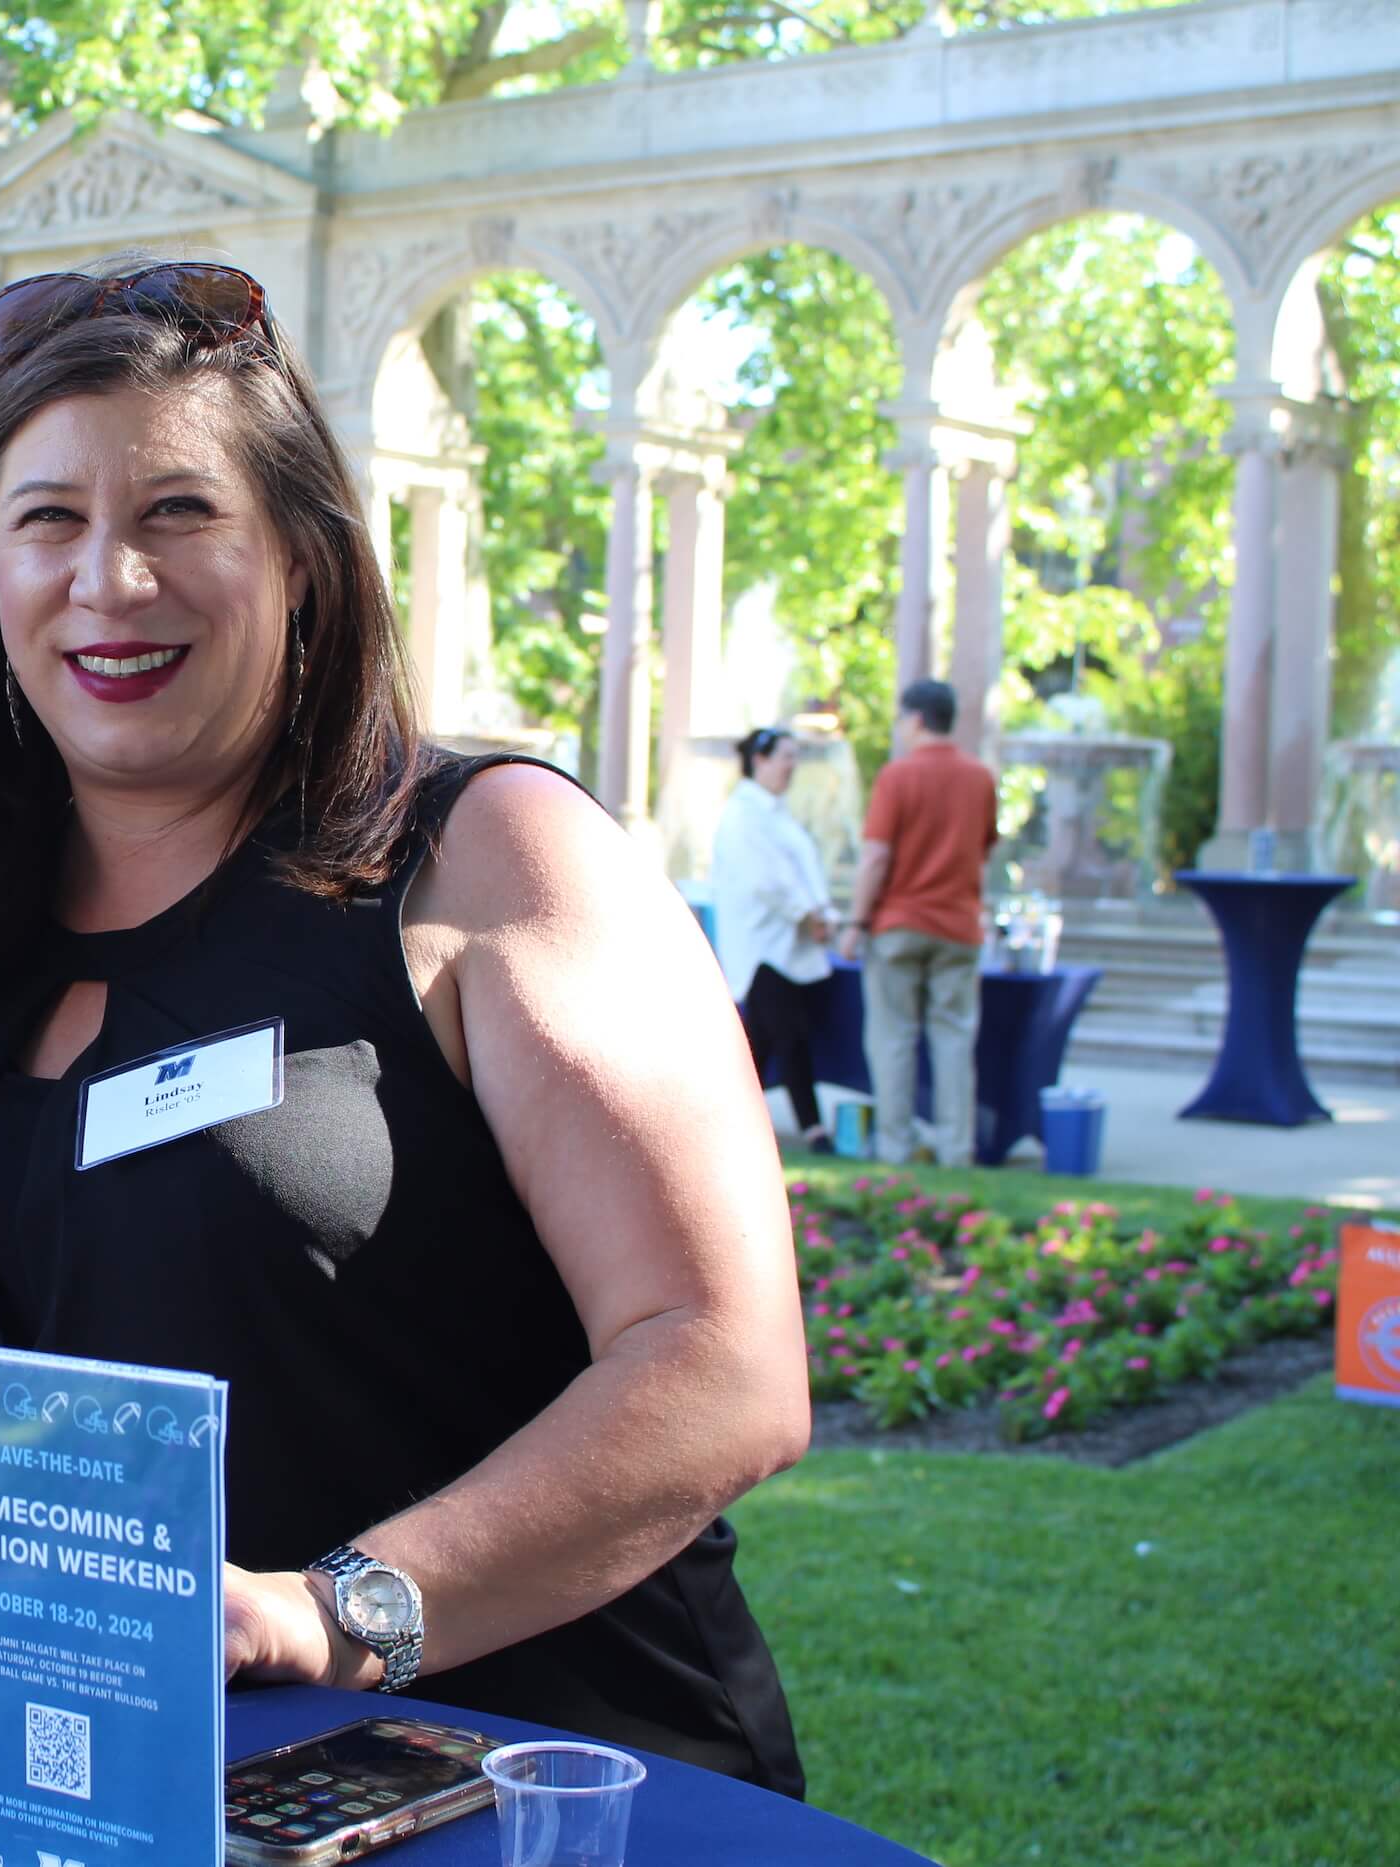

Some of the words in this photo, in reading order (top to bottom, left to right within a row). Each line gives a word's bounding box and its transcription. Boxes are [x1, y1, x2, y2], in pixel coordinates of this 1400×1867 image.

[144, 1081, 204, 1106] Lindsay
[153, 1523, 173, 1552] &
[57, 1545, 197, 1597] WEEKEND
[49, 1603, 103, 1635] 18-20,
[108, 1614, 155, 1642] 2024
[21, 1640, 58, 1658] TAILGATE
[59, 1648, 79, 1664] WILL
[81, 1653, 102, 1668] TAKE
[104, 1657, 130, 1675] PLACE
[132, 1664, 146, 1678] ON
[40, 1659, 77, 1677] OCTOBER
[79, 1667, 88, 1681] 19
[90, 1670, 123, 1688] BEFORE
[21, 1670, 44, 1686] GAME
[46, 1675, 60, 1689] VS.
[62, 1679, 77, 1694] THE
[79, 1683, 112, 1700] BRYANT
[115, 1691, 159, 1711] BULLDOGS
[0, 1807, 16, 1820] AND
[17, 1811, 44, 1828] OTHER
[46, 1819, 88, 1839] UPCOMING
[89, 1830, 119, 1848] EVENTS
[5, 1796, 28, 1811] MORE
[29, 1802, 83, 1826] INFORMATION
[84, 1816, 97, 1829] ON
[98, 1819, 154, 1844] HOMECOMING
